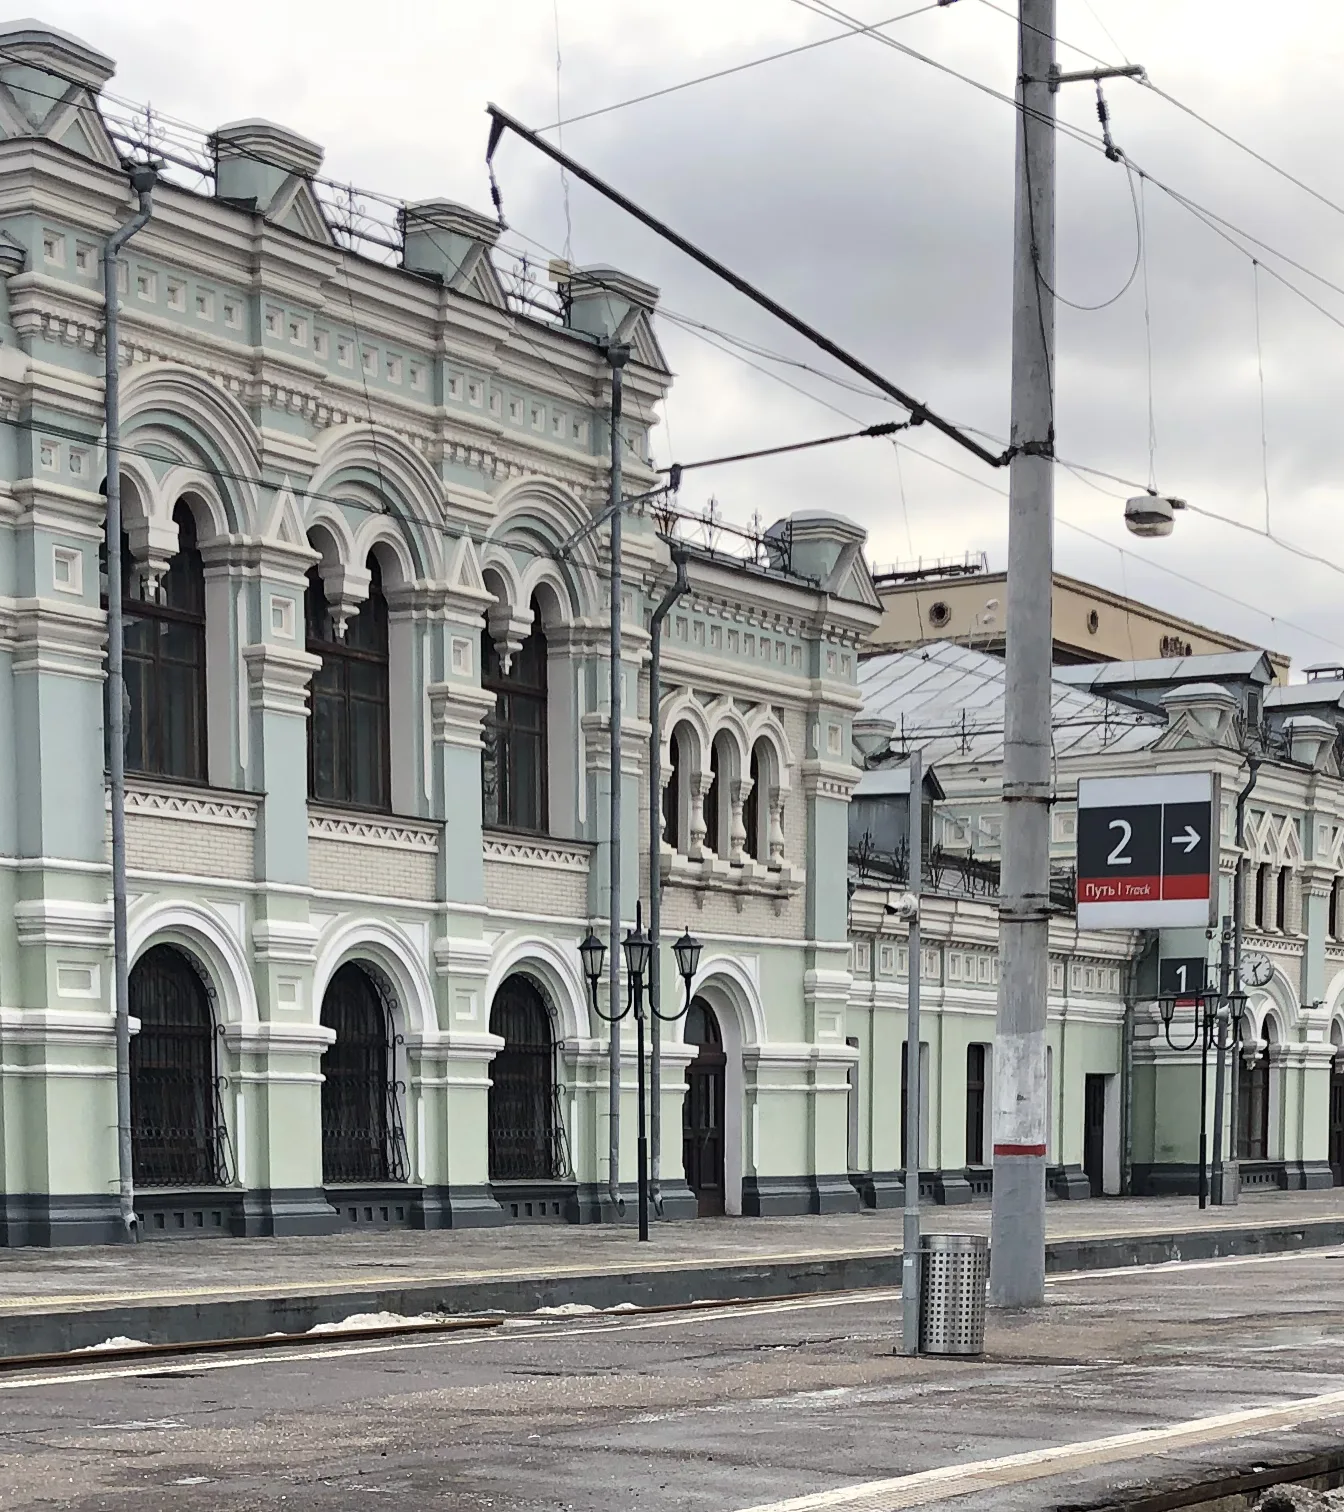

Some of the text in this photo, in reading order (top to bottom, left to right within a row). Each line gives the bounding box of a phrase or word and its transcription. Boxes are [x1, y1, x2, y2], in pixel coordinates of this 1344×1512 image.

[1107, 819, 1132, 865] 2
[1086, 883, 1151, 900] Путь Track
[1176, 965, 1187, 993] 1
